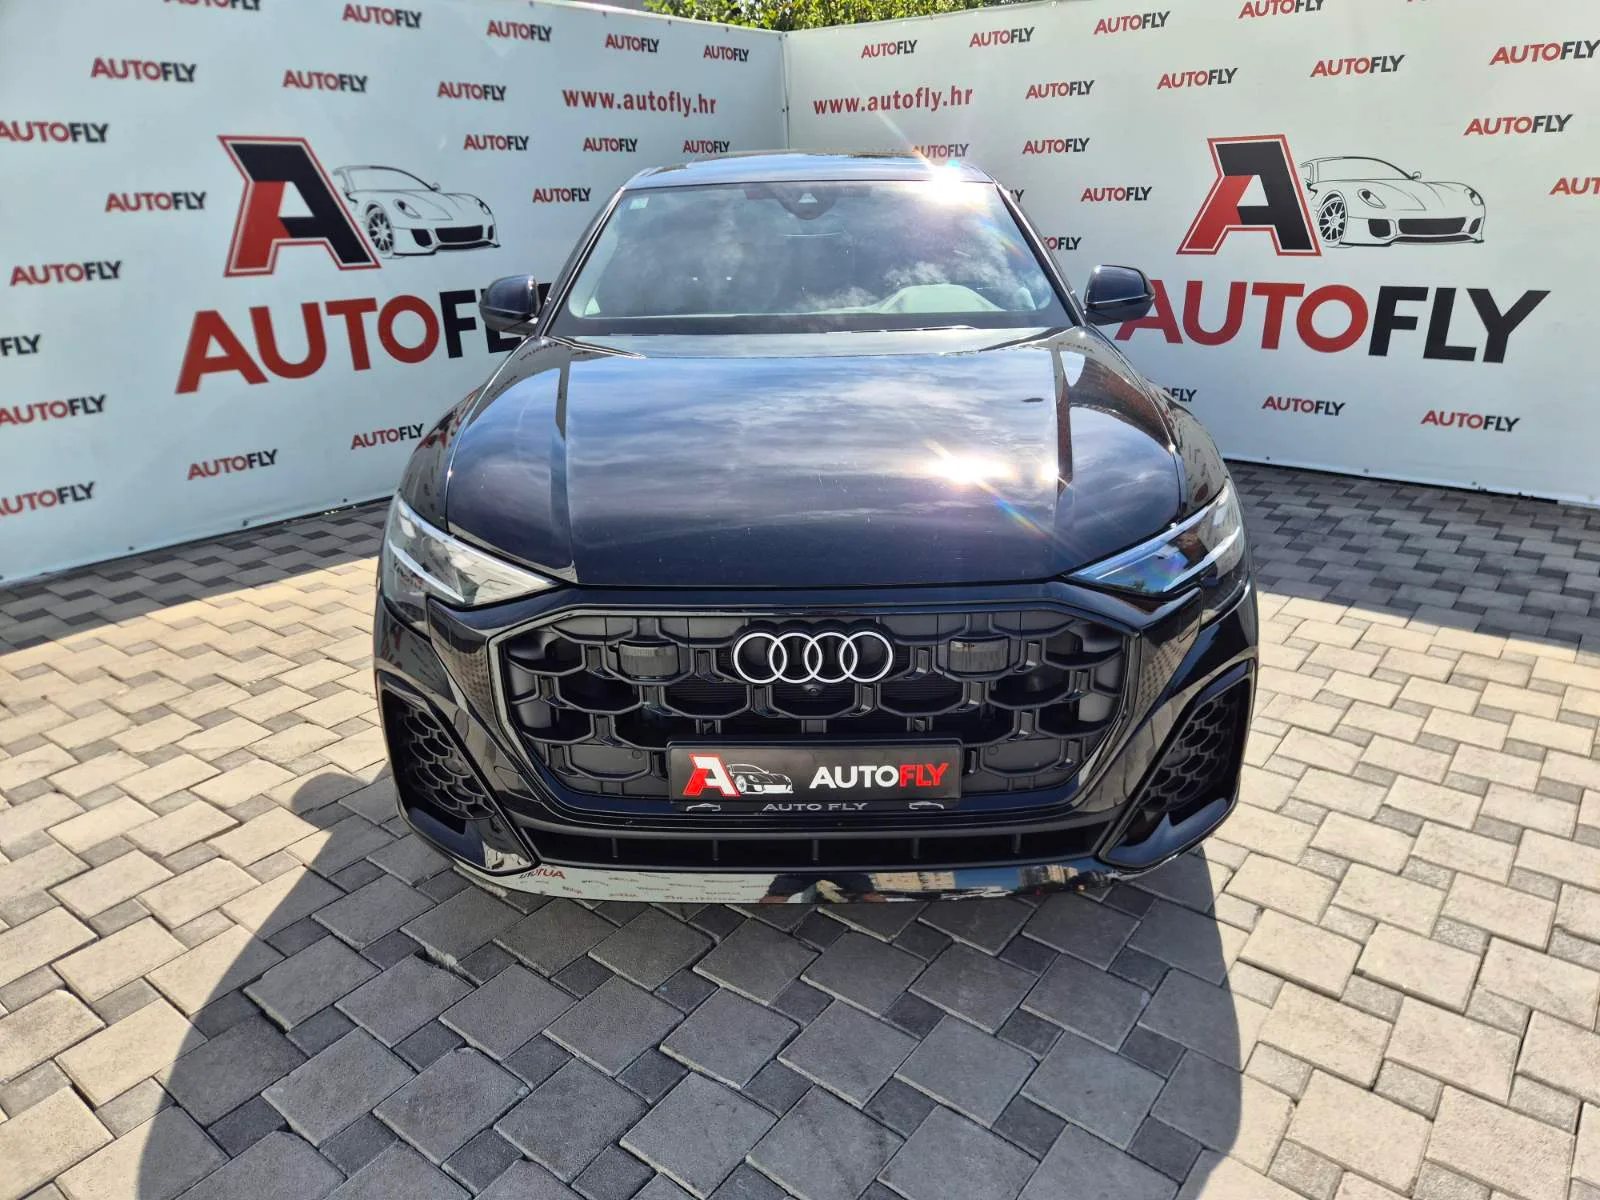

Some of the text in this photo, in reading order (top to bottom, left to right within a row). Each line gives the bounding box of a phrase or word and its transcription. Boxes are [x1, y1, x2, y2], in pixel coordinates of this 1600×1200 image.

[343, 4, 422, 28] AUTOFLY
[1094, 11, 1170, 34] AUTOFLY
[487, 20, 552, 42] AUTOFLY
[970, 27, 1034, 47] AUTOFLY
[605, 34, 660, 53] AUTOFLY
[704, 45, 749, 62] AUTOFLY
[861, 40, 917, 58] AUTOFLY
[1490, 40, 1600, 65] AUTOFLY
[91, 58, 196, 82] AUTOFLY
[1310, 55, 1405, 77] AUTOFLY
[283, 70, 367, 93] AUTOFLY
[1157, 68, 1238, 89] AUTOFLY
[438, 82, 506, 101] AUTOFLY
[1026, 80, 1094, 99] AUTOFLY
[563, 89, 716, 117] www.autofly.hr
[813, 86, 972, 115] www.autofly.hr
[0, 121, 108, 143] AUTOFLY
[1464, 114, 1573, 135] AUTOFLY
[464, 135, 529, 151] AUTOFLY
[583, 138, 637, 152] AUTOFLY
[683, 140, 730, 153] AUTOFLY
[1022, 138, 1089, 154] AUTOFLY
[106, 192, 206, 212] AUTOFLY
[533, 188, 591, 202] AUTOFLY
[1081, 186, 1152, 201] AUTOFLY
[10, 261, 121, 286] AUTOFLY
[1115, 279, 1551, 364] AUTOFLY
[175, 283, 551, 394] AUTOF
[1262, 396, 1345, 416] AUTOFLY
[1421, 411, 1520, 432] AUTOFLY
[351, 424, 424, 450] AUTOFLY
[188, 449, 277, 480] AUTOFLY
[809, 762, 948, 789] AUTOFLY
[763, 803, 868, 811] AUTO FLY
